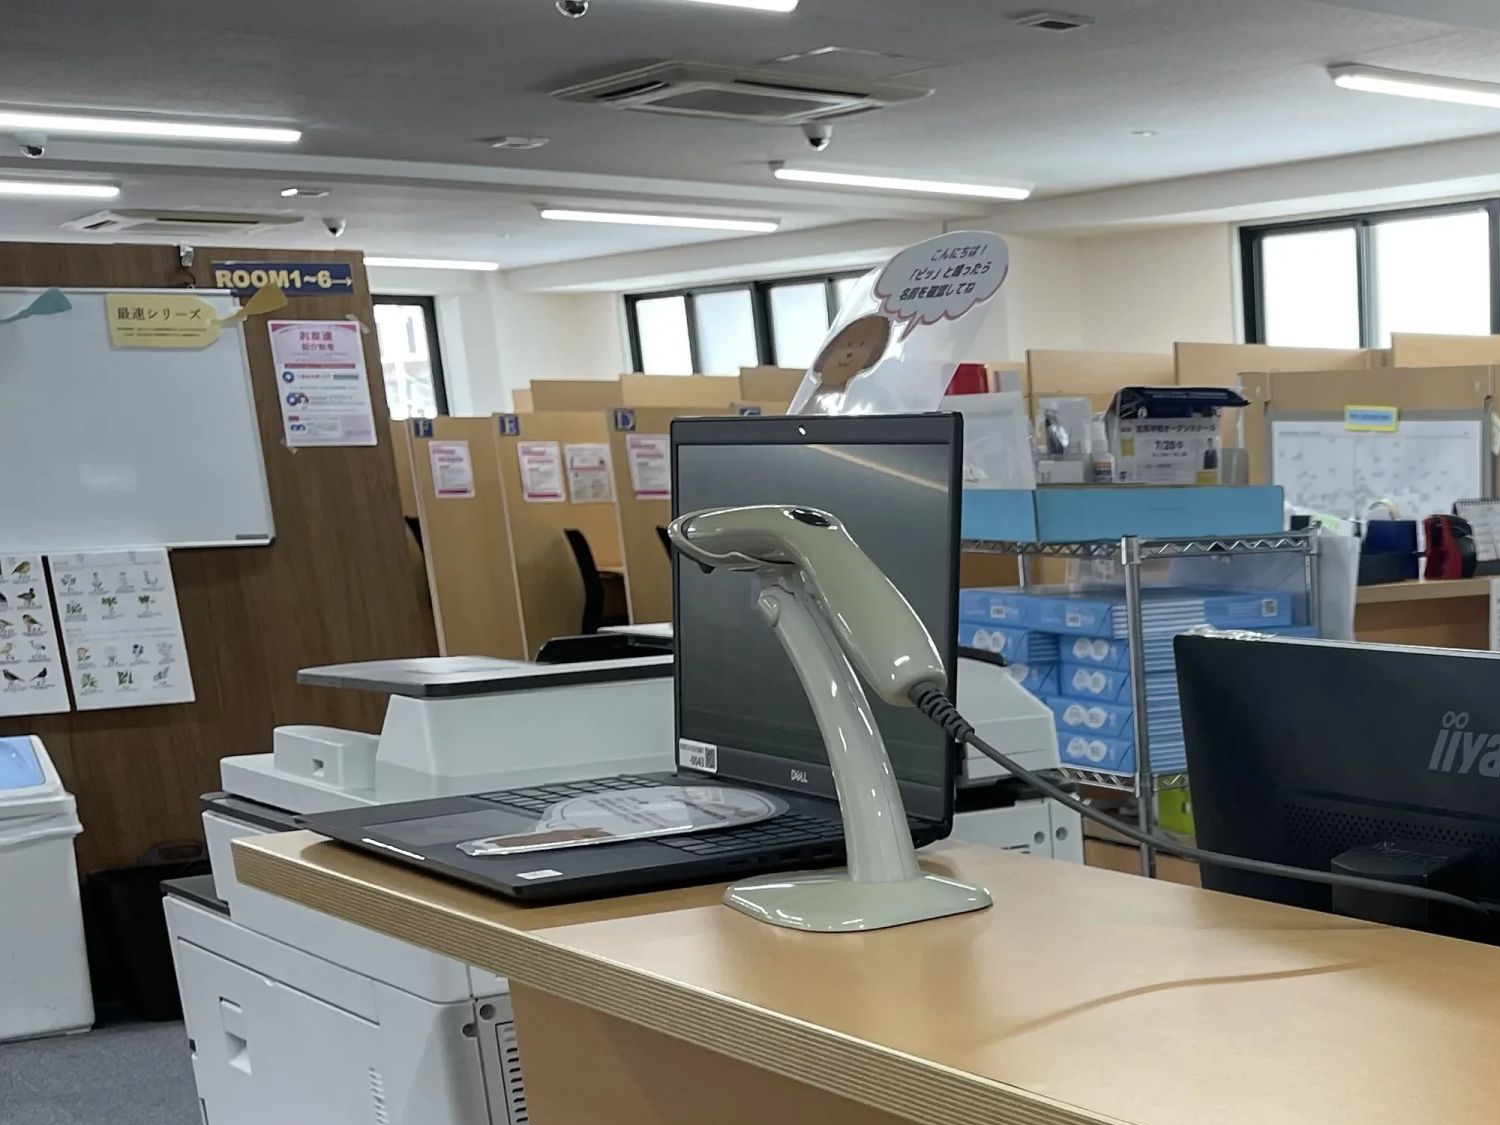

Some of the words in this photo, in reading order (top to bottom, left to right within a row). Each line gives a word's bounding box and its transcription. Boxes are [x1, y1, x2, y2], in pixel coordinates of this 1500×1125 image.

[117, 306, 201, 321] 最速シリーズ
[616, 409, 634, 430] D
[790, 768, 808, 783] DELL
